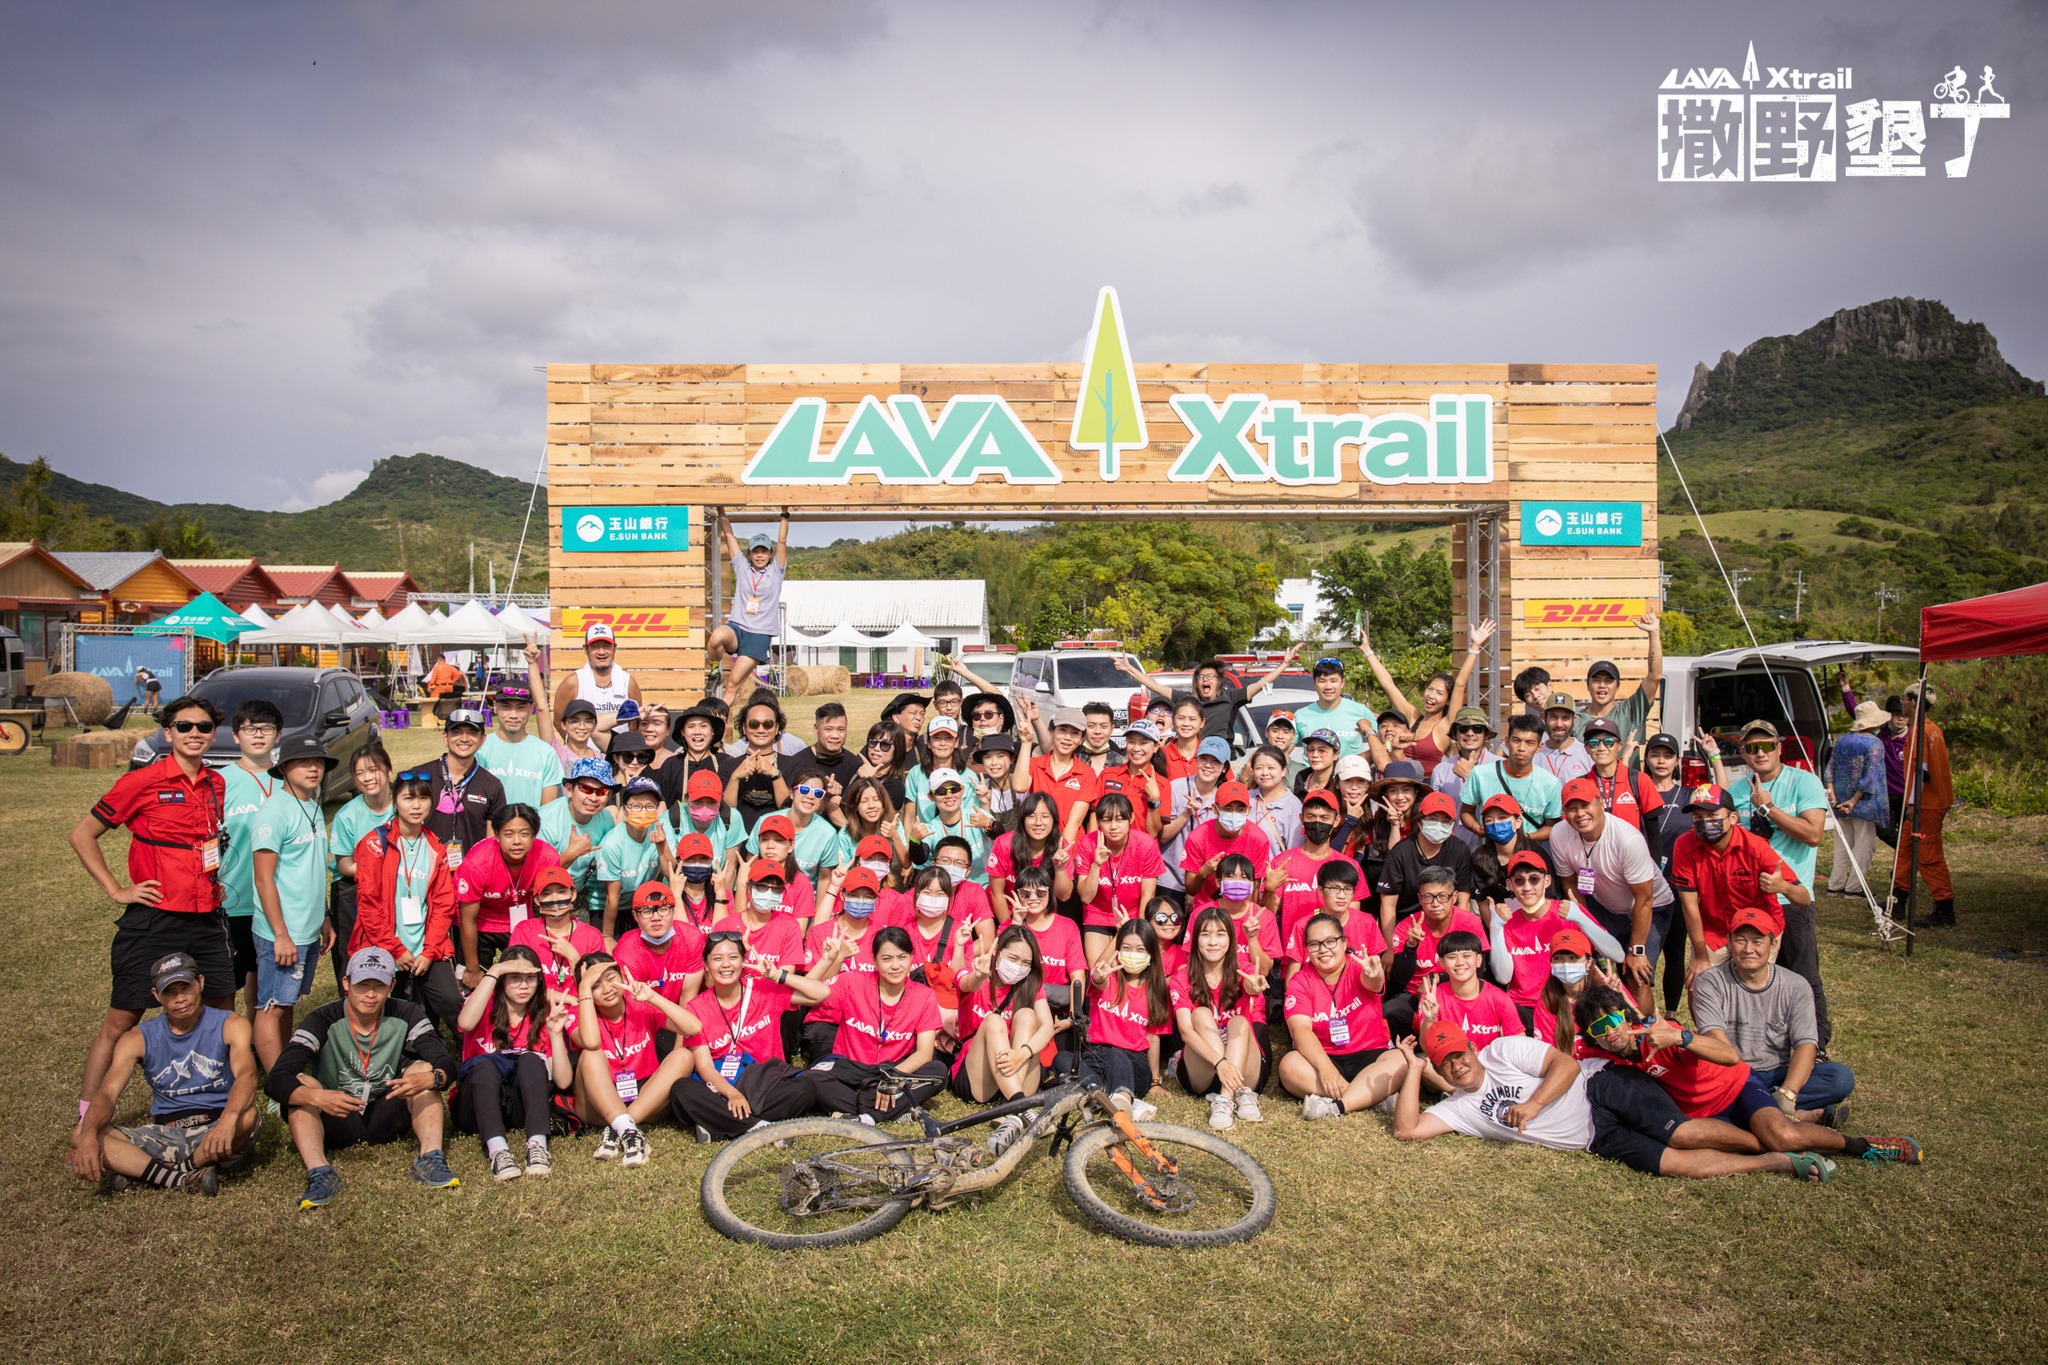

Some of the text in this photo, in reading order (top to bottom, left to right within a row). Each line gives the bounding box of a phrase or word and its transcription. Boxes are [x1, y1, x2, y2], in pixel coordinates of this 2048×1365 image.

[742, 394, 1494, 486] LAVA Xtrail
[609, 517, 668, 531] 玉山銀行
[1567, 512, 1623, 525] 玉山銀行
[1541, 604, 1630, 622] DHL
[580, 613, 673, 632] DHL
[91, 667, 125, 677] LAVA
[597, 702, 621, 711] silve
[227, 804, 259, 817] LAVA
[410, 868, 427, 880] Xtr
[1098, 874, 1142, 886] VA Xtra
[1284, 882, 1312, 892] LAVA
[773, 904, 794, 914] trai
[1511, 946, 1537, 956] LAVA
[858, 962, 876, 972] Xtr
[1042, 955, 1066, 967] Xtra
[669, 971, 686, 982] Xtr
[1128, 1011, 1149, 1026] Xtra
[740, 1014, 771, 1038] Xtrail
[845, 1017, 914, 1040] LAVA Xtra
[1471, 1023, 1502, 1035] Xtra
